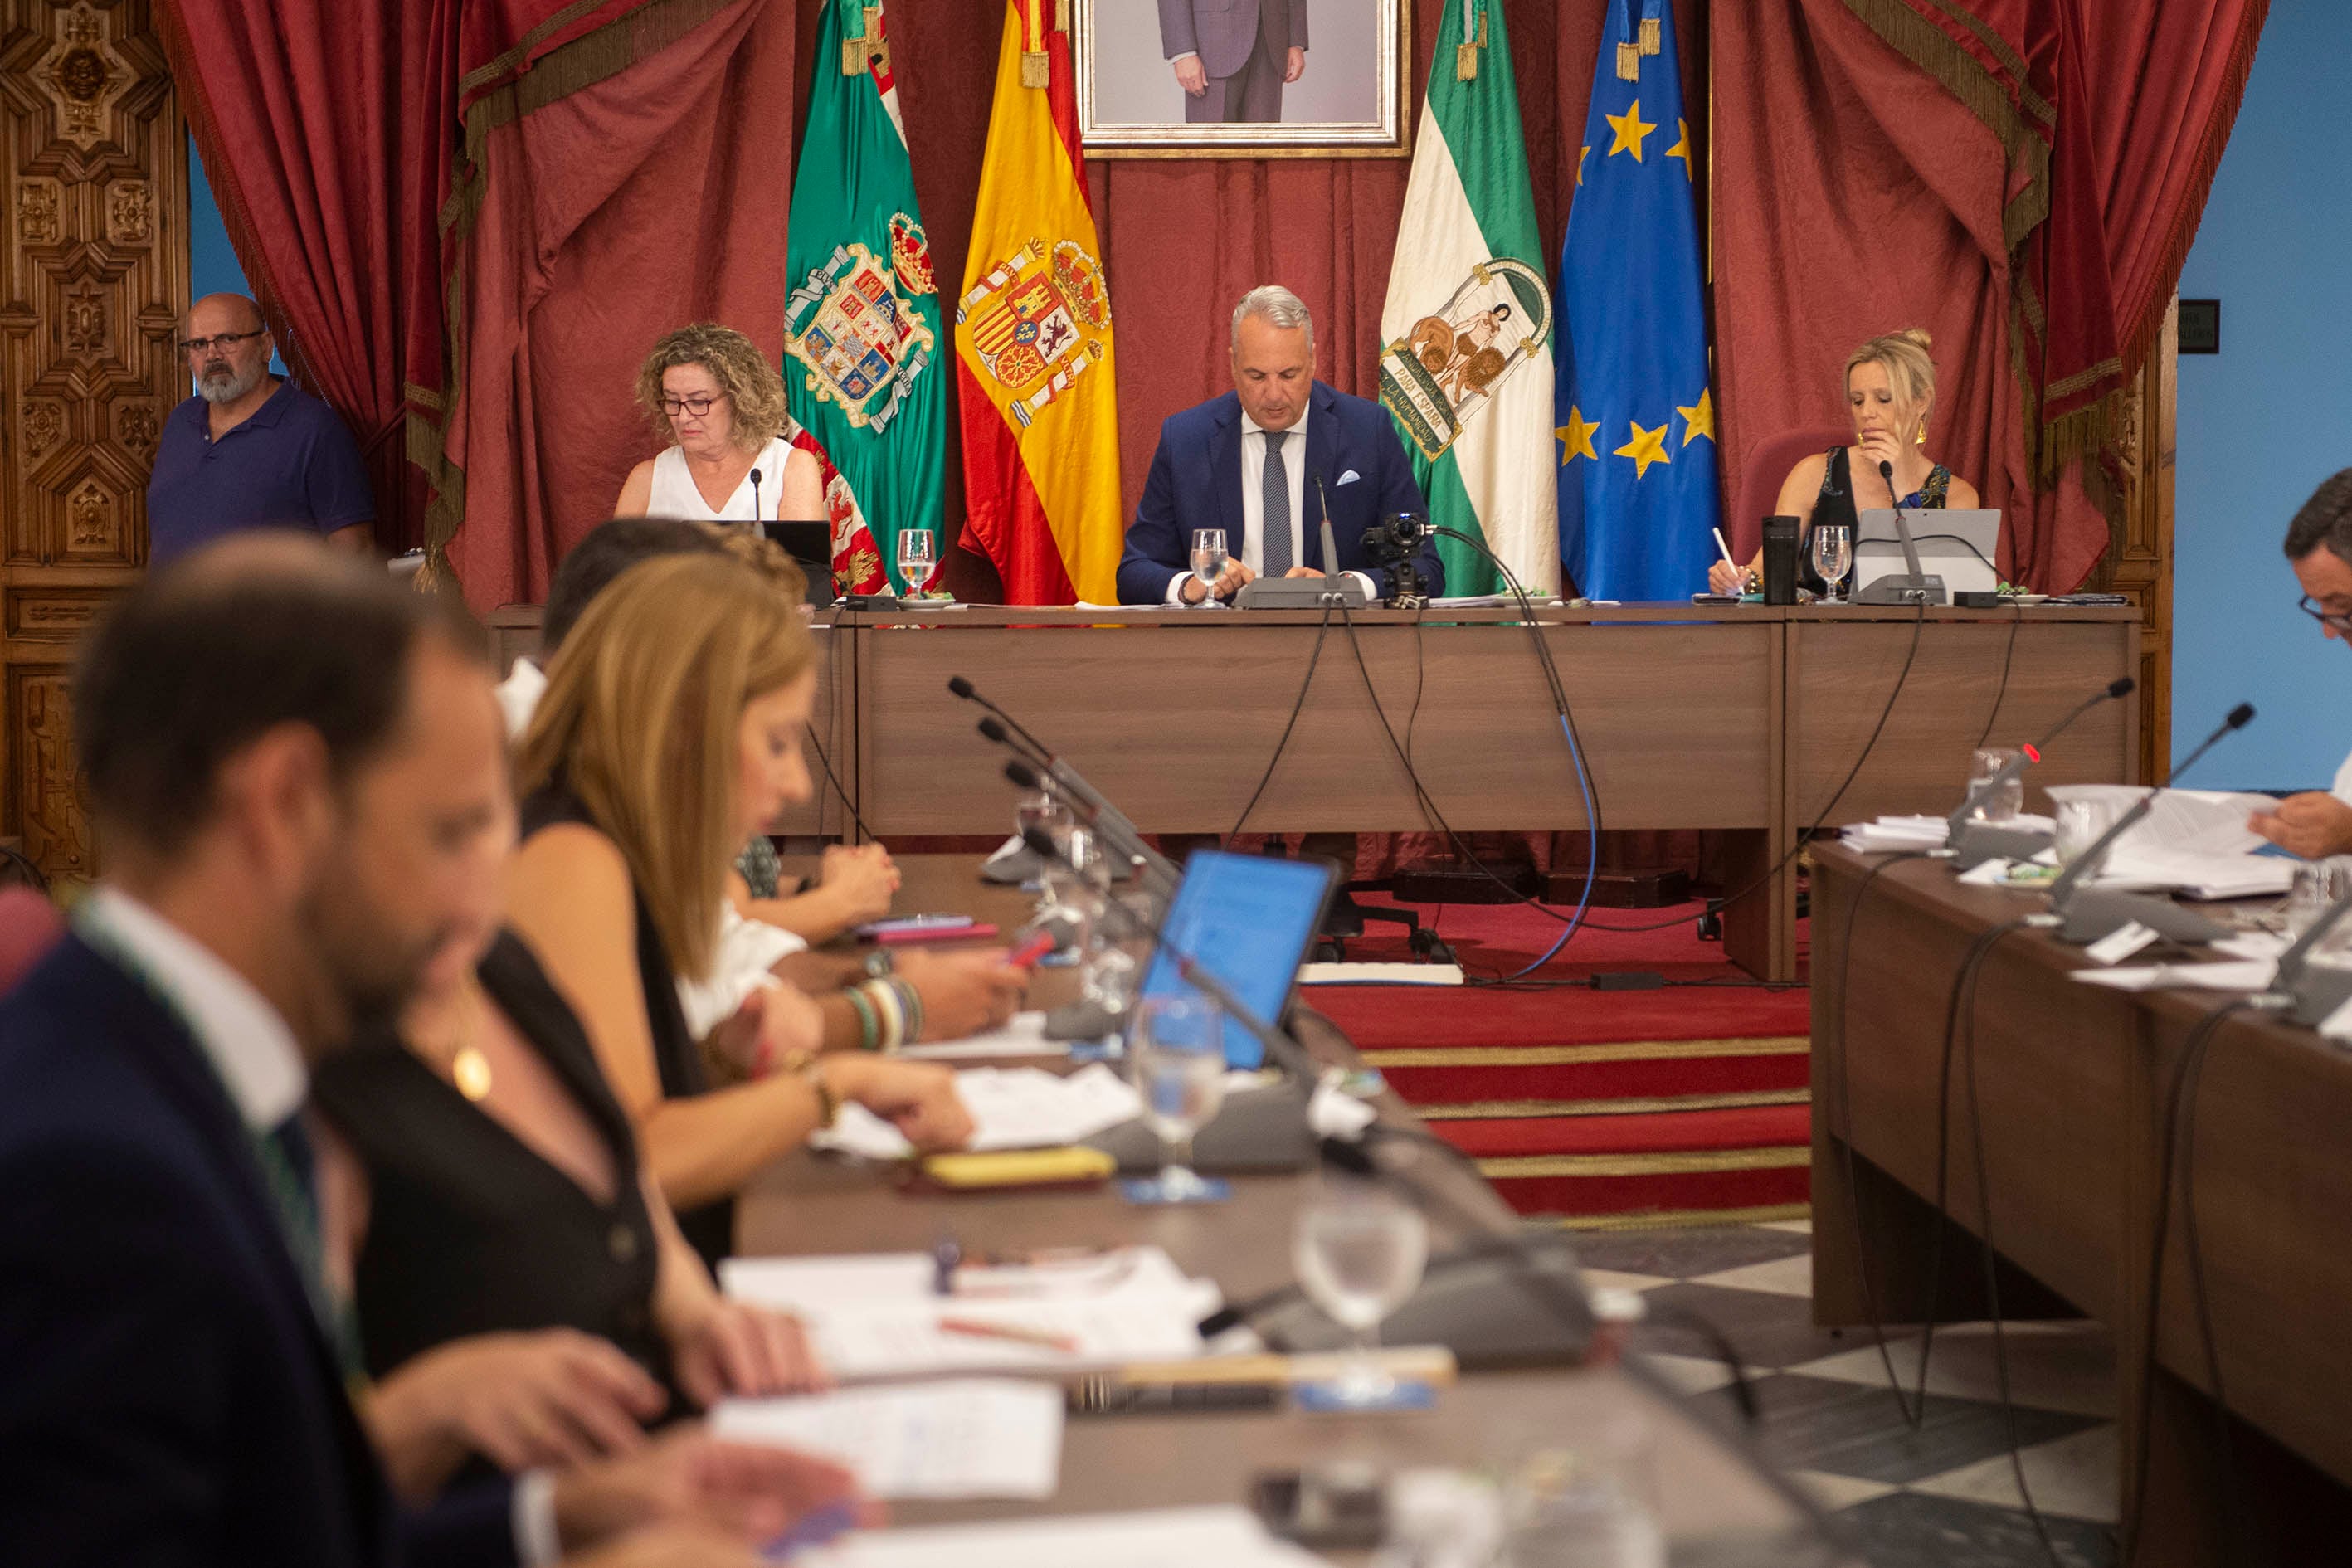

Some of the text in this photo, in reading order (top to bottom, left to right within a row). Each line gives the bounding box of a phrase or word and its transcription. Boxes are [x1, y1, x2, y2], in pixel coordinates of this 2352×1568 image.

[815, 270, 834, 288] PLVS
[998, 262, 1018, 283] PLVS
[1062, 356, 1075, 387] VLTRA
[1395, 368, 1415, 394] PARA
[1387, 383, 1404, 398] LA
